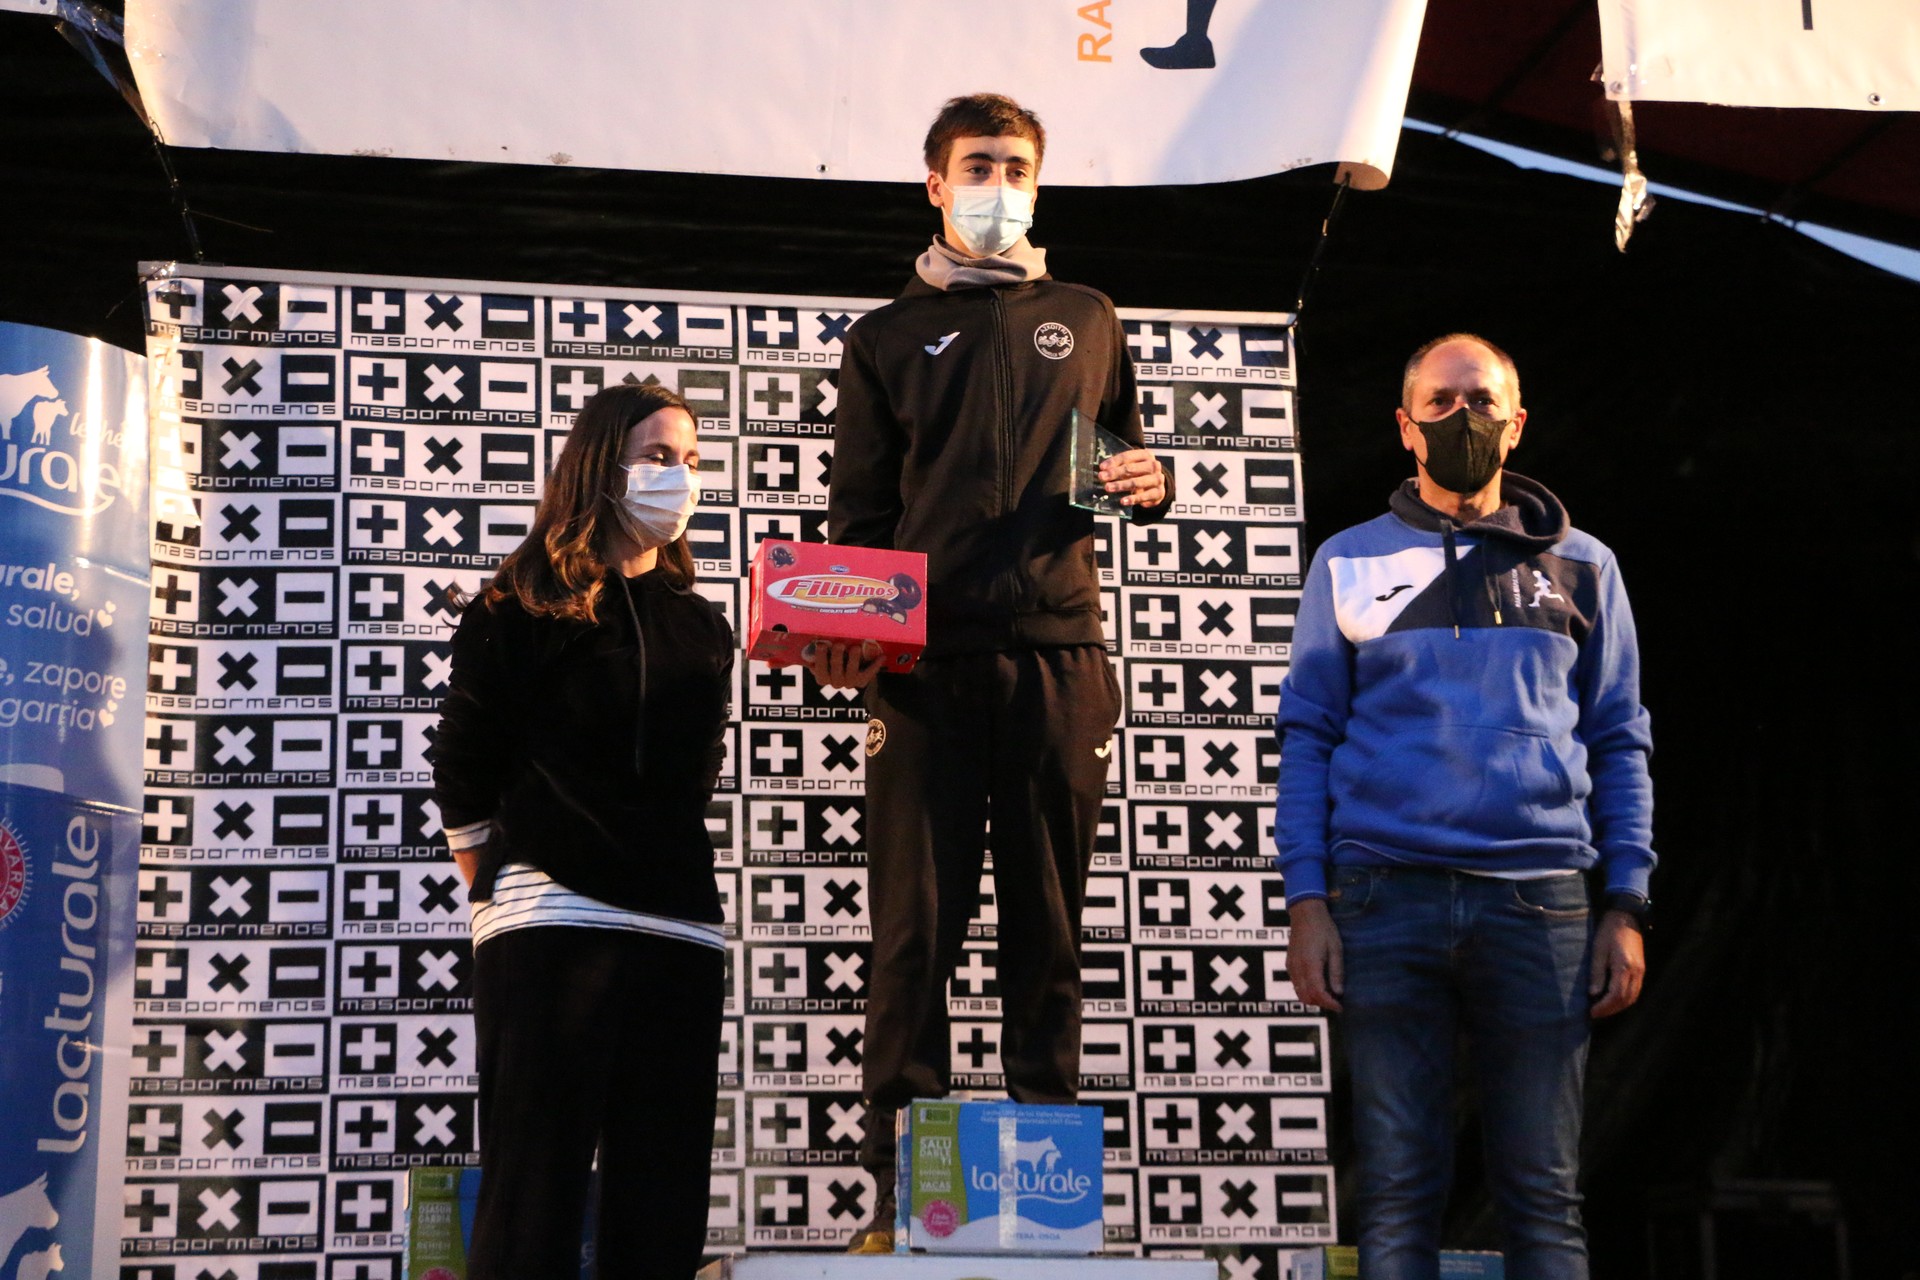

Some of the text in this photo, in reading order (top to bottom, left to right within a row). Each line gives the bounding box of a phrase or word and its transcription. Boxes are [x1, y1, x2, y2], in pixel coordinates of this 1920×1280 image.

[150, 321, 336, 343] maspormenos
[350, 335, 535, 352] maspormenos
[551, 343, 733, 360] maspormenos
[747, 350, 841, 363] maspor
[1136, 365, 1291, 380] aspormenos
[172, 400, 336, 415] spormenos
[349, 406, 536, 423] maspormenos
[70, 412, 125, 448] lehe
[746, 421, 836, 435] maspor
[1143, 435, 1295, 448] aspormenos
[187, 474, 336, 488] spormenos
[349, 477, 535, 493] maspormenos
[1174, 503, 1297, 516] pormenos
[153, 543, 335, 561] maspormenos
[348, 549, 503, 565] maspormen
[1128, 571, 1301, 586] maspormenos
[779, 579, 895, 599] Filipinos
[6, 601, 95, 637] salud
[348, 623, 450, 635] maspor
[1130, 642, 1288, 655] maspormeno
[24, 661, 127, 700] zapore
[346, 697, 445, 709] maspor
[749, 706, 865, 720] masporm
[1132, 711, 1277, 725] maspormen
[750, 779, 866, 791] masporm
[1134, 784, 1278, 796] maspormen
[343, 846, 447, 859] maspor
[750, 851, 867, 864] masporm
[342, 922, 466, 934] masporm
[751, 925, 870, 937] masporm
[1139, 928, 1287, 939] maspormen
[36, 815, 100, 1154] lacturale
[751, 999, 868, 1012] masporm
[338, 1075, 479, 1088] masporme
[1143, 1075, 1323, 1087] maspormenos
[336, 1153, 480, 1167] masporme
[971, 1165, 1092, 1194] lacturale
[753, 1228, 852, 1241] maspor
